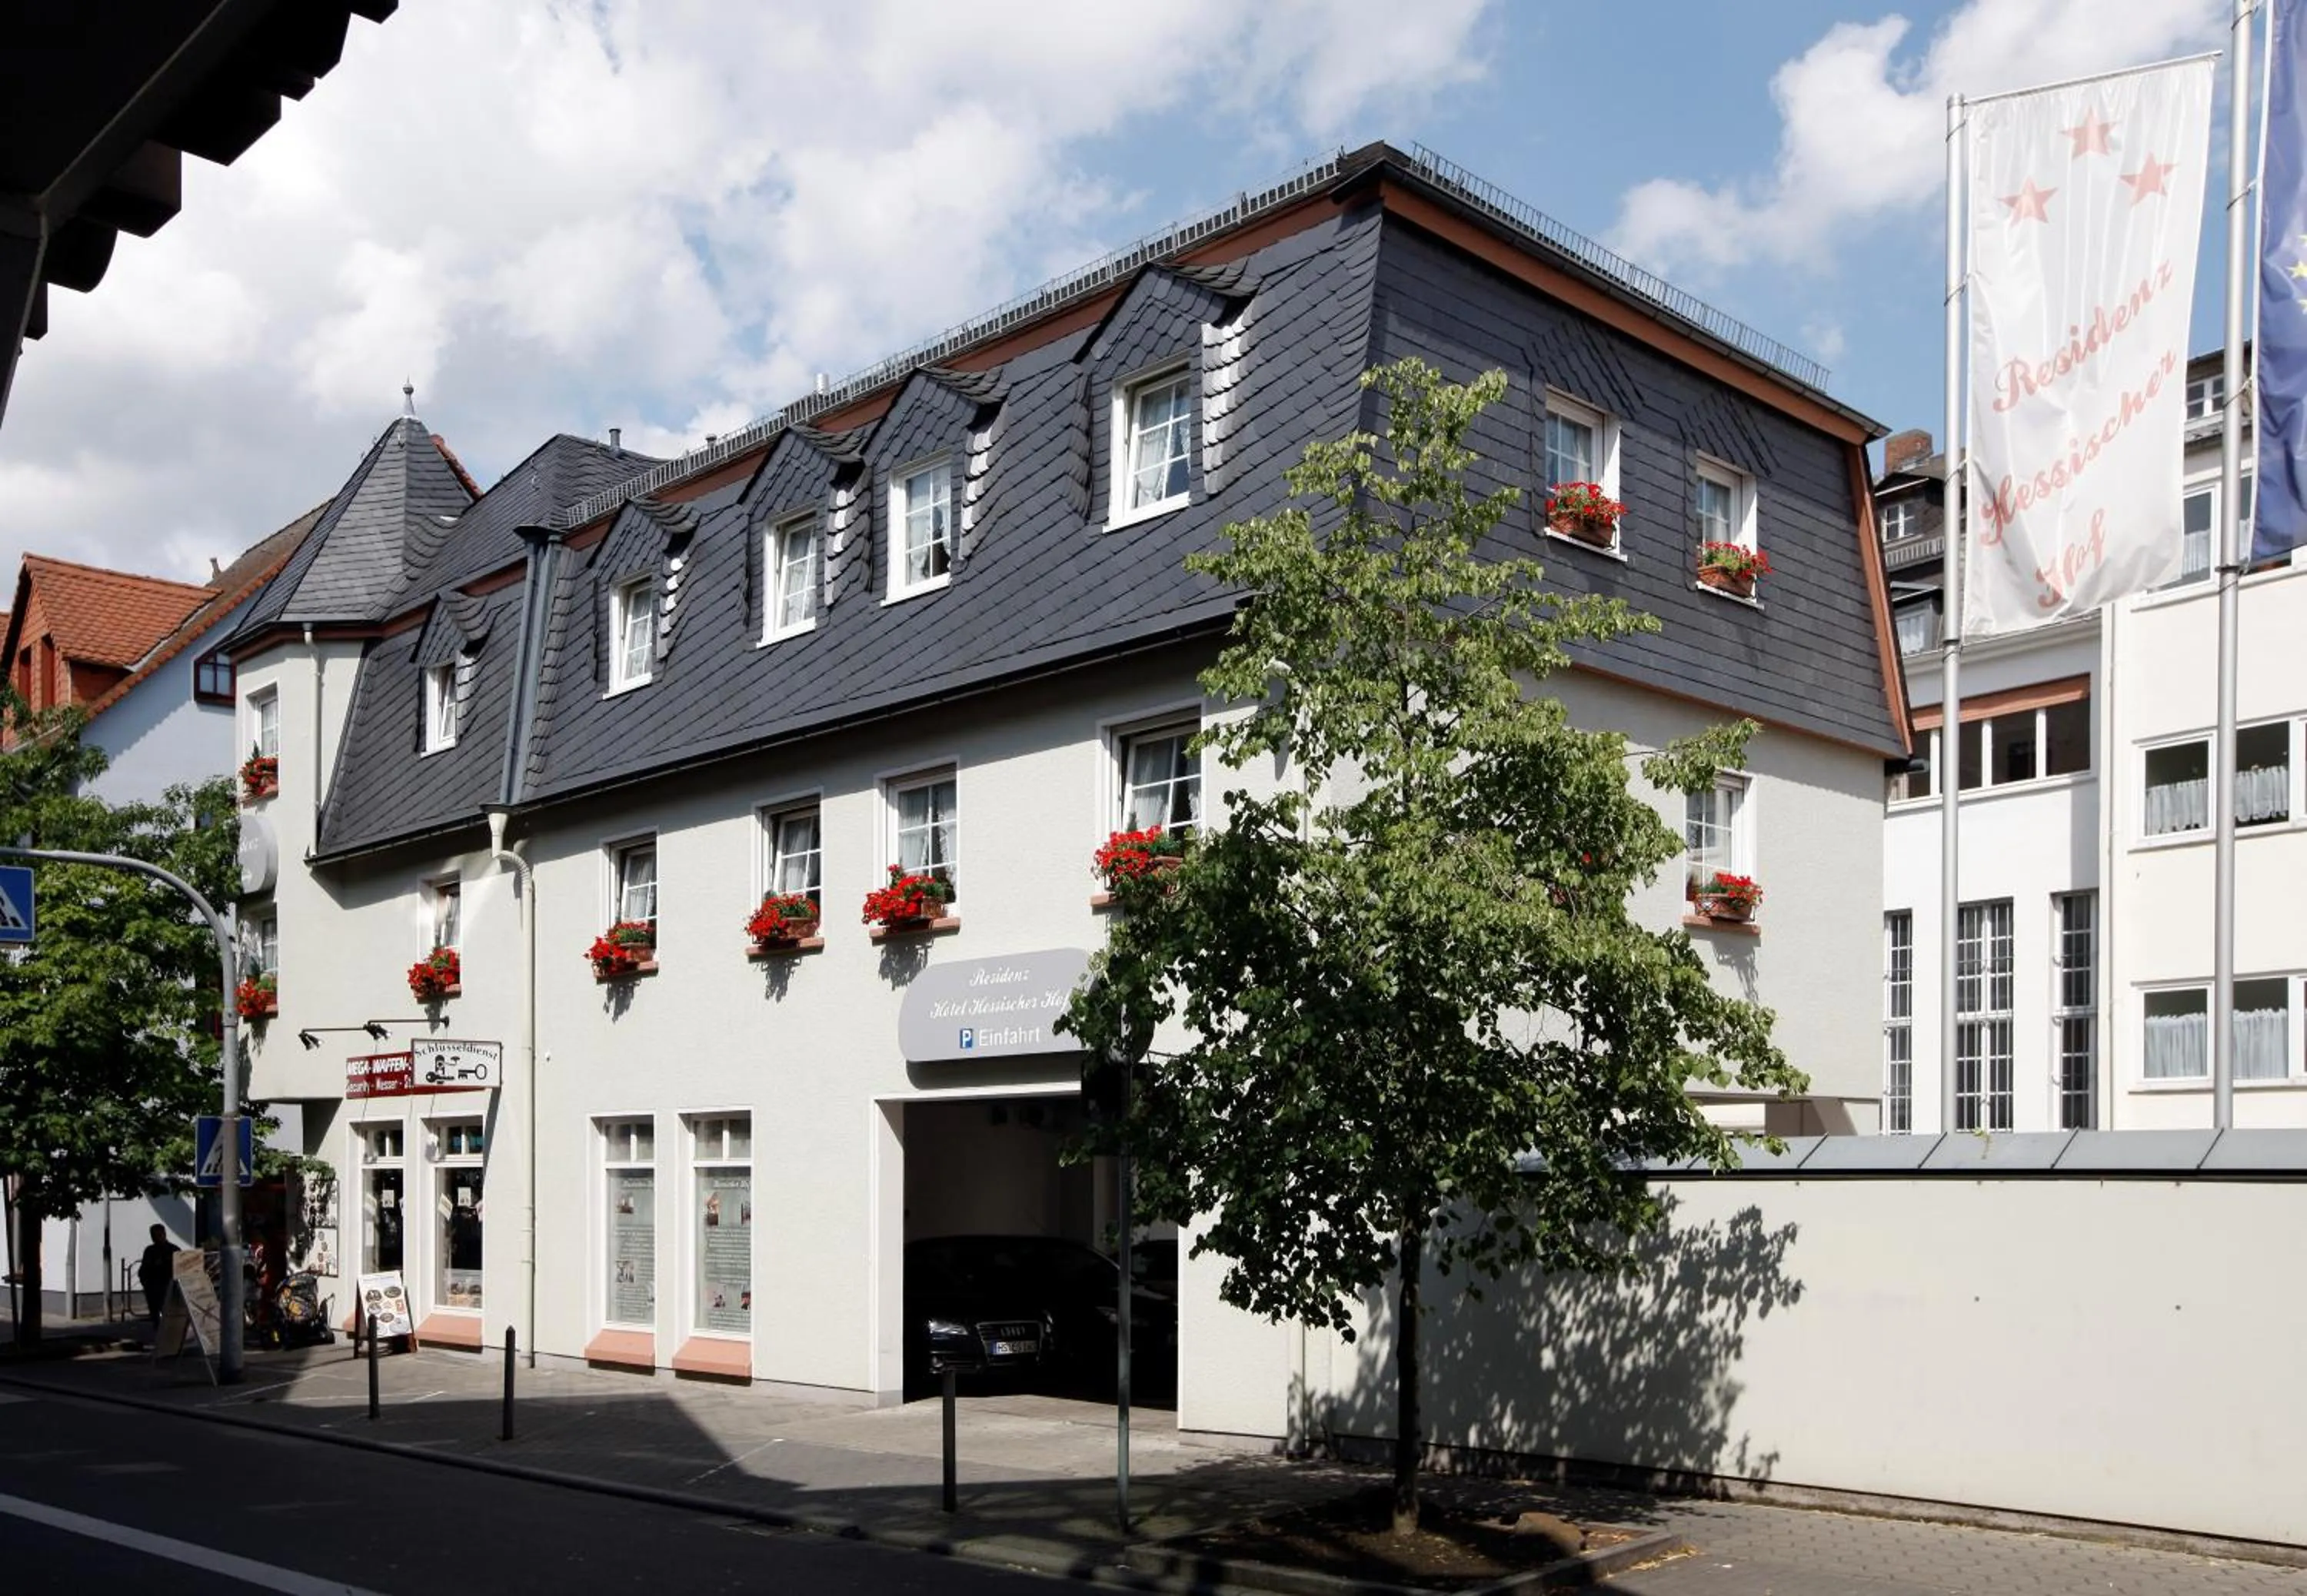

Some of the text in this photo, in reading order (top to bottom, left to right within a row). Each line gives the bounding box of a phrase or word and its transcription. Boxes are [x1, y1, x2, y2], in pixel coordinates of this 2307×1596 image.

[1993, 259, 2172, 412] Residenz
[1980, 348, 2176, 545] Hessischer
[2036, 507, 2106, 608] Hof
[930, 999, 967, 1019] Hotel
[1041, 988, 1072, 1013] Hof
[970, 967, 1030, 986] Residenz
[962, 1026, 1040, 1047] P Einfahrt
